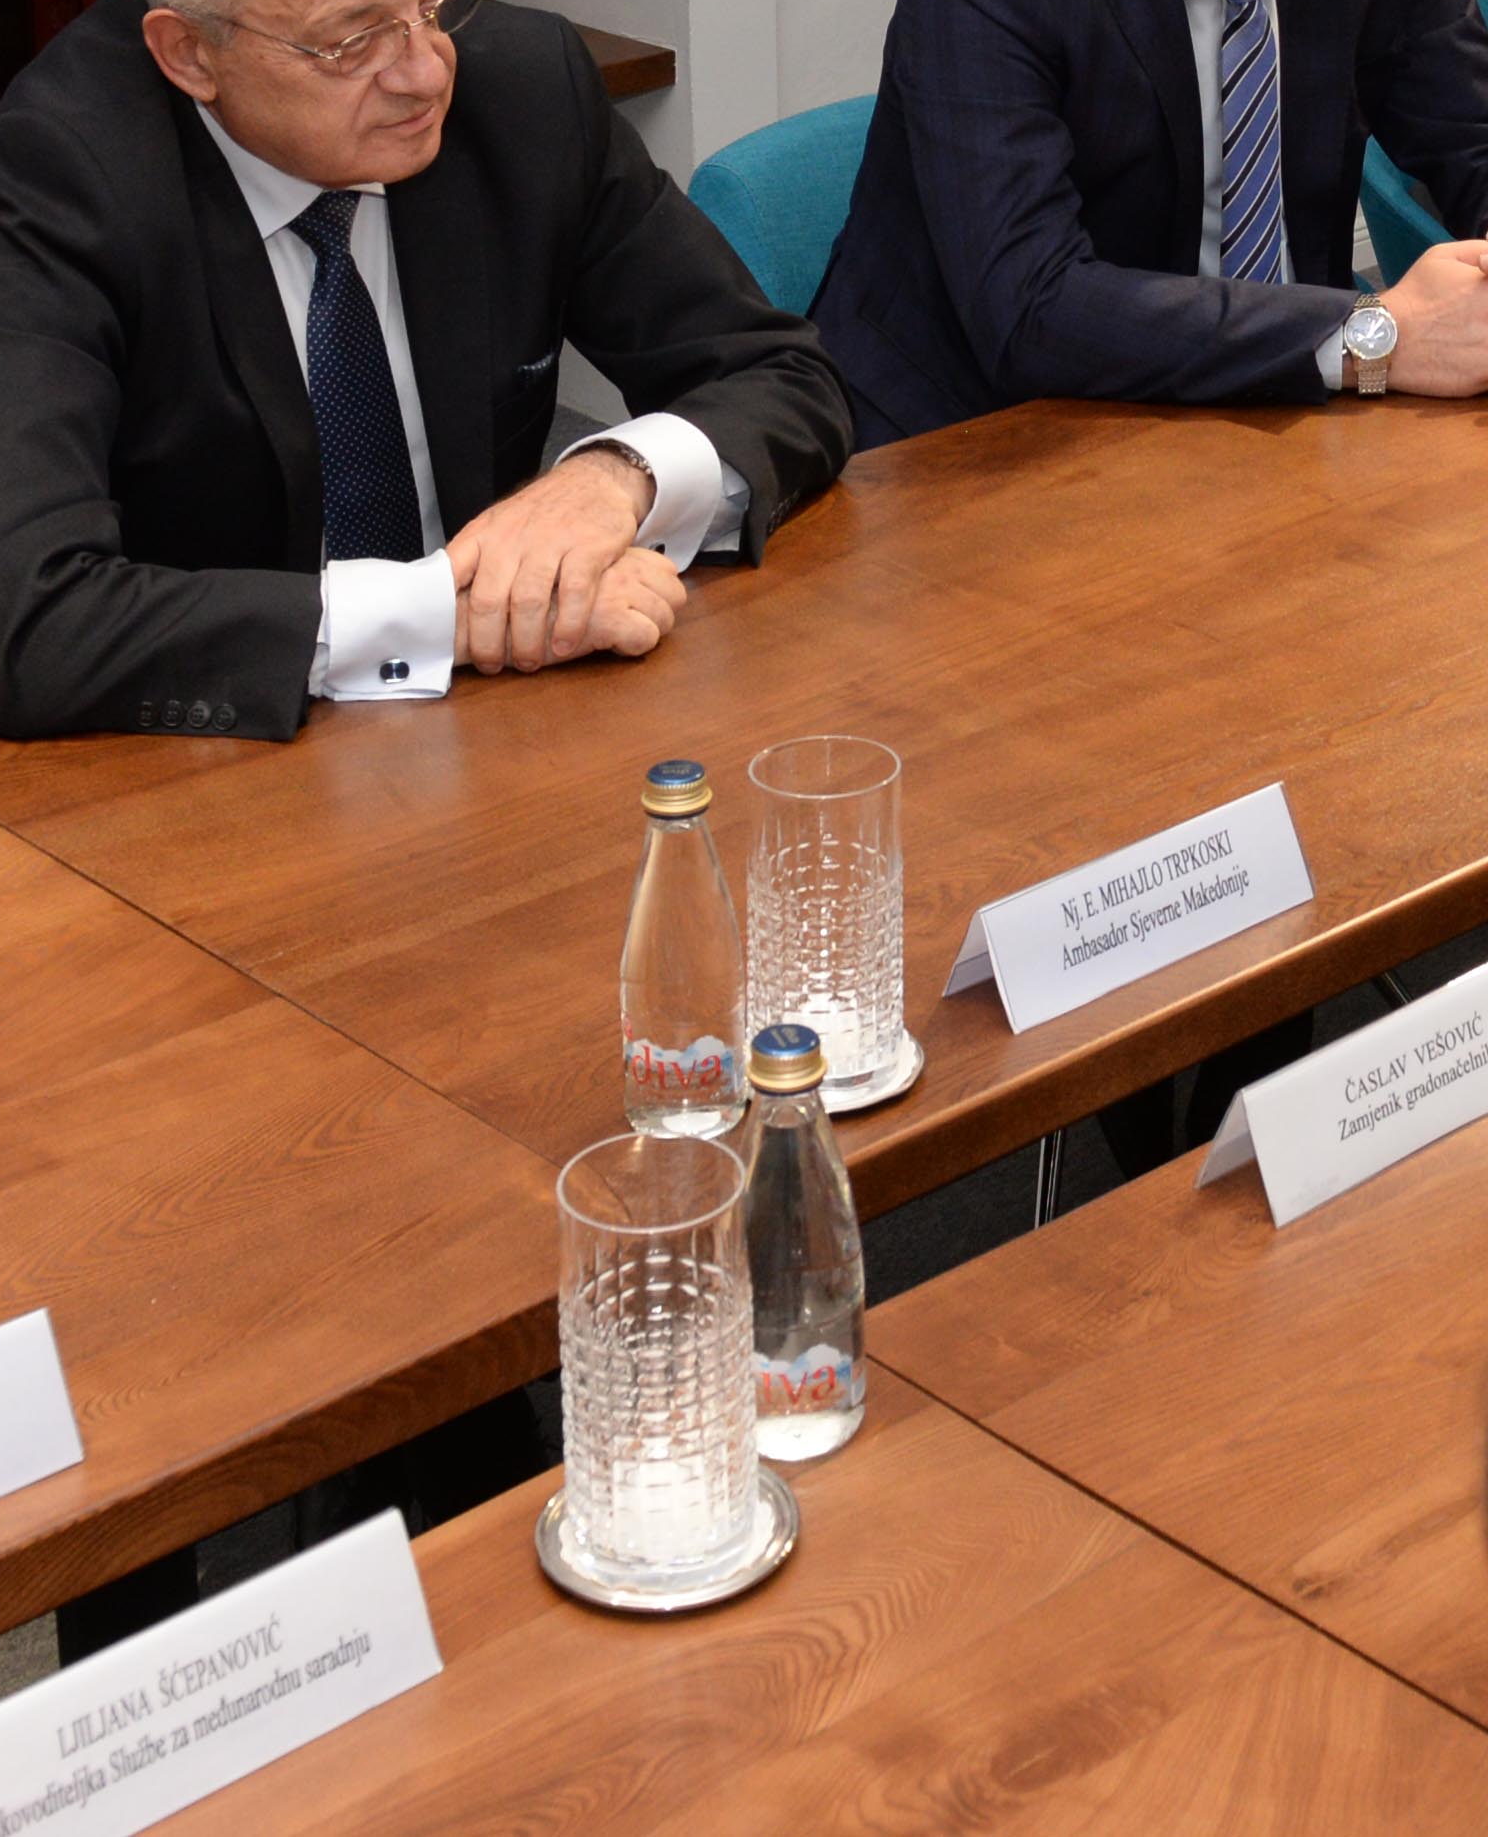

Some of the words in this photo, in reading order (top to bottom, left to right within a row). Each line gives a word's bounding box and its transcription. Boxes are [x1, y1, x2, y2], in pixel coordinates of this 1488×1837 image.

[1060, 900, 1084, 931] Nj.
[1085, 890, 1100, 919] E.
[1099, 861, 1164, 912] MIHAJLO
[1162, 829, 1234, 888] TRPKOSKI
[1062, 918, 1130, 971] Ambasador
[1130, 896, 1183, 943] Sjeverne
[1181, 864, 1250, 916] Makedonije
[632, 1044, 721, 1091] diva
[1343, 1052, 1408, 1104] ČASLAV
[1413, 1010, 1485, 1066] VEŠOVIĆ
[1338, 1093, 1403, 1142] Zamjenik
[761, 1365, 837, 1405] iva
[56, 1691, 153, 1760] LJILJANA
[158, 1612, 285, 1709] ŠĆEPANOVIĆ
[109, 1723, 168, 1785] Službe
[169, 1728, 191, 1754] za
[193, 1668, 303, 1740] međunarodnu
[304, 1628, 372, 1685] saradnju
